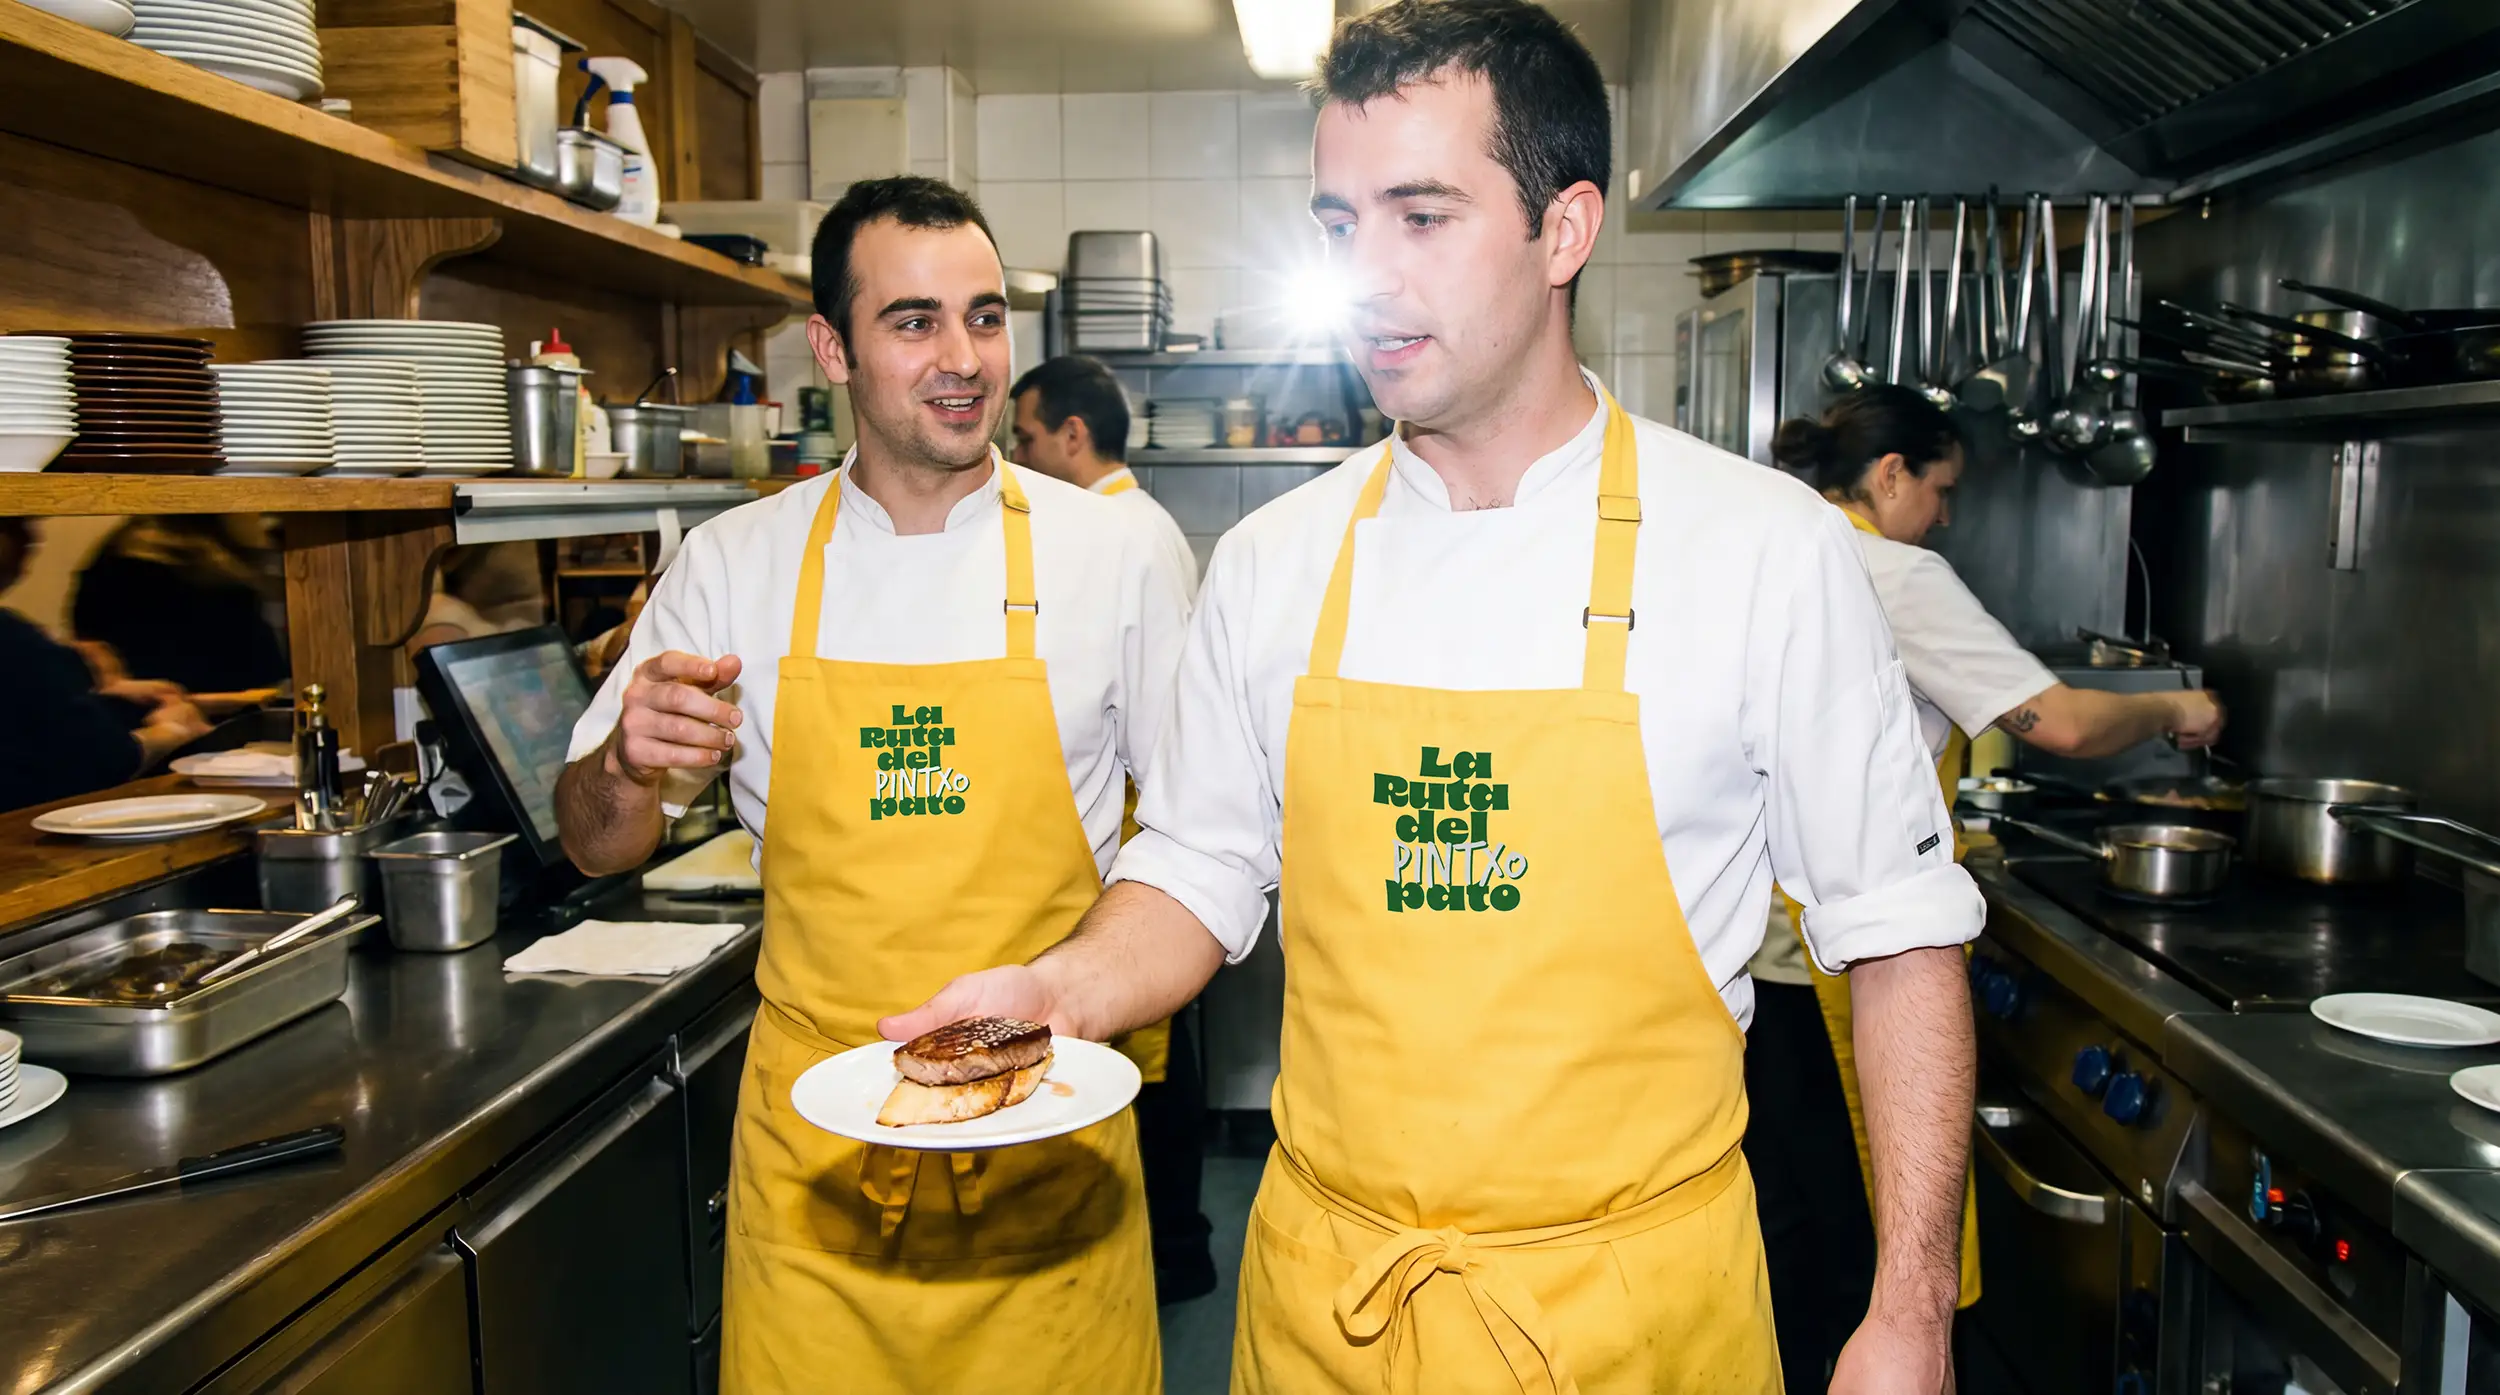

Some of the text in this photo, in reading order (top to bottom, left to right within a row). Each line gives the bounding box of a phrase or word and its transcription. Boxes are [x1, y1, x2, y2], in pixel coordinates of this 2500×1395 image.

[892, 705, 943, 725] La
[860, 724, 955, 748] Ruta
[877, 746, 941, 771] del
[1420, 746, 1492, 779] La
[1373, 773, 1509, 811] Ruta
[869, 795, 966, 820] pato
[1395, 810, 1488, 845] del
[1385, 879, 1521, 913] pato
